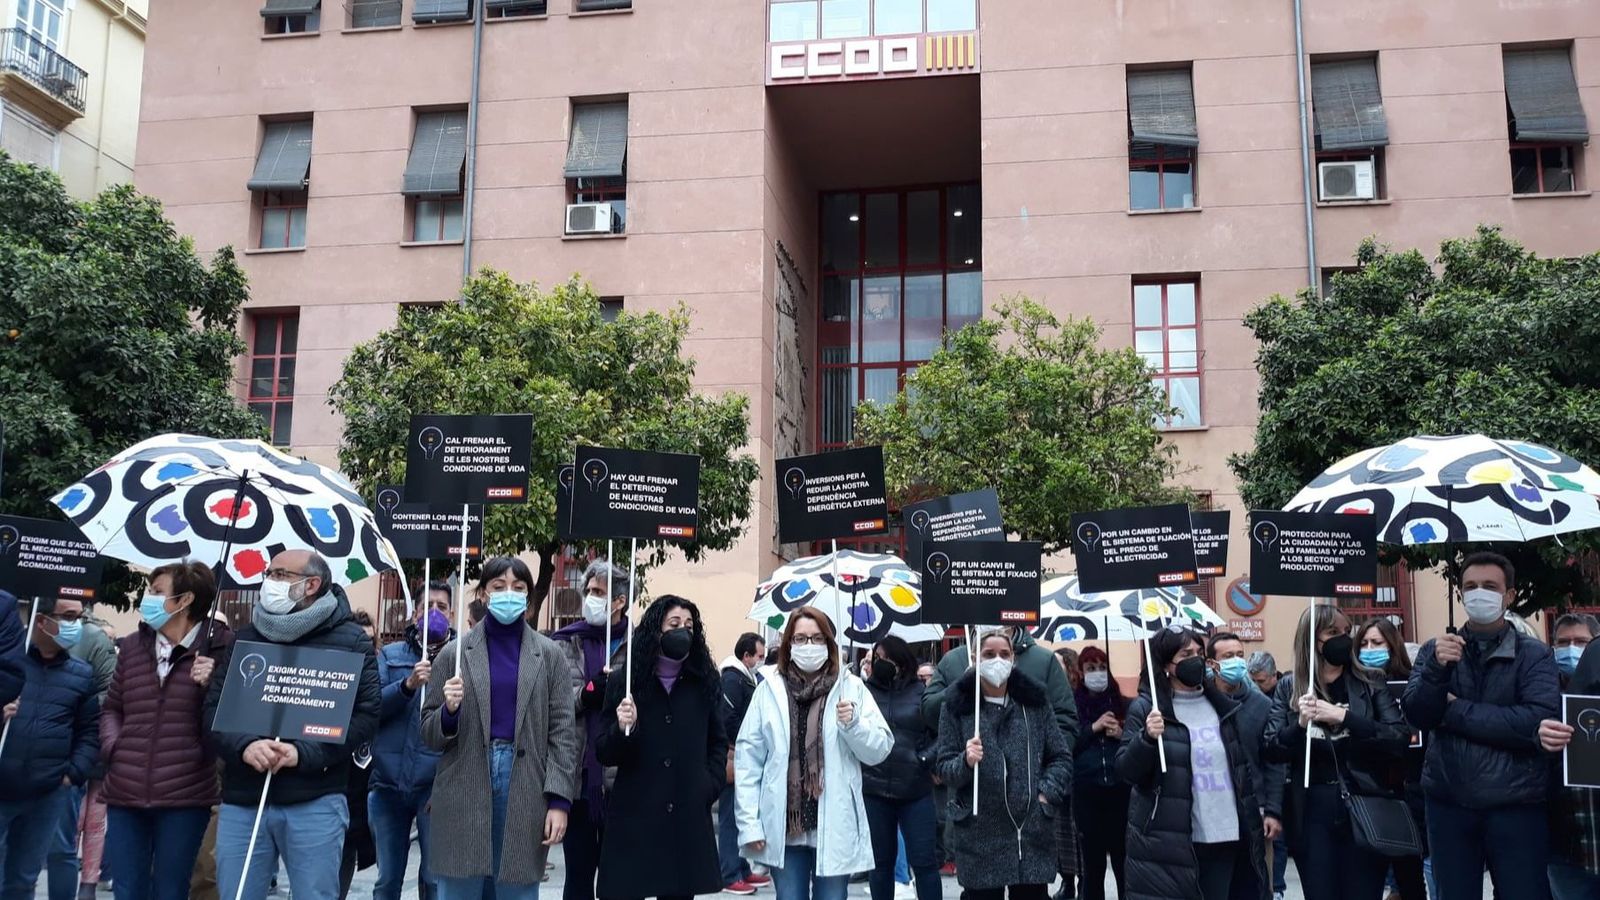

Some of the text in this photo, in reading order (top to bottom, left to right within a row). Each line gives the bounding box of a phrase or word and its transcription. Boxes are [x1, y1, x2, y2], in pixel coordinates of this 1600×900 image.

[771, 37, 917, 80] CCOO
[647, 476, 678, 485] FRENAR
[806, 474, 845, 485] INVERSIONS
[622, 484, 667, 493] DETERIORO
[807, 486, 830, 494] REDUIR
[842, 481, 869, 489] NOSTRA
[622, 494, 664, 503] NUESTRAS
[807, 492, 856, 503] DEPENDÈNCIA
[853, 498, 885, 507] EXTERNA
[609, 502, 664, 513] CONDICIONES
[930, 511, 964, 522] INVERSIONS
[931, 520, 953, 529] REDUIR
[962, 515, 986, 524] NOSTRA
[854, 522, 874, 530] CCOO
[933, 524, 975, 536] DEPENDÈNCIA
[973, 526, 1001, 536] EXTERNA
[1101, 530, 1118, 538] POR
[1133, 528, 1160, 536] CAMBIO
[1281, 530, 1329, 539] PROTECCIÓN
[21, 536, 48, 545] EXIGIM
[1113, 537, 1144, 545] SISTEMA
[1158, 533, 1191, 541] FIJACIÓN
[32, 546, 78, 556] MECANISME
[1116, 553, 1168, 563] ELECTRICIDAD
[18, 561, 86, 573] ACOMIADAMENTS
[1008, 570, 1037, 578] FIXACIÓ
[268, 666, 355, 681] EXIGIM QUE S'ACTIVE
[279, 676, 329, 688] MECANISME
[330, 682, 348, 690] RED
[264, 684, 311, 696] PER EVITAR
[261, 694, 335, 708] ACOMIADAMENTS
[305, 726, 330, 734] CCOO
